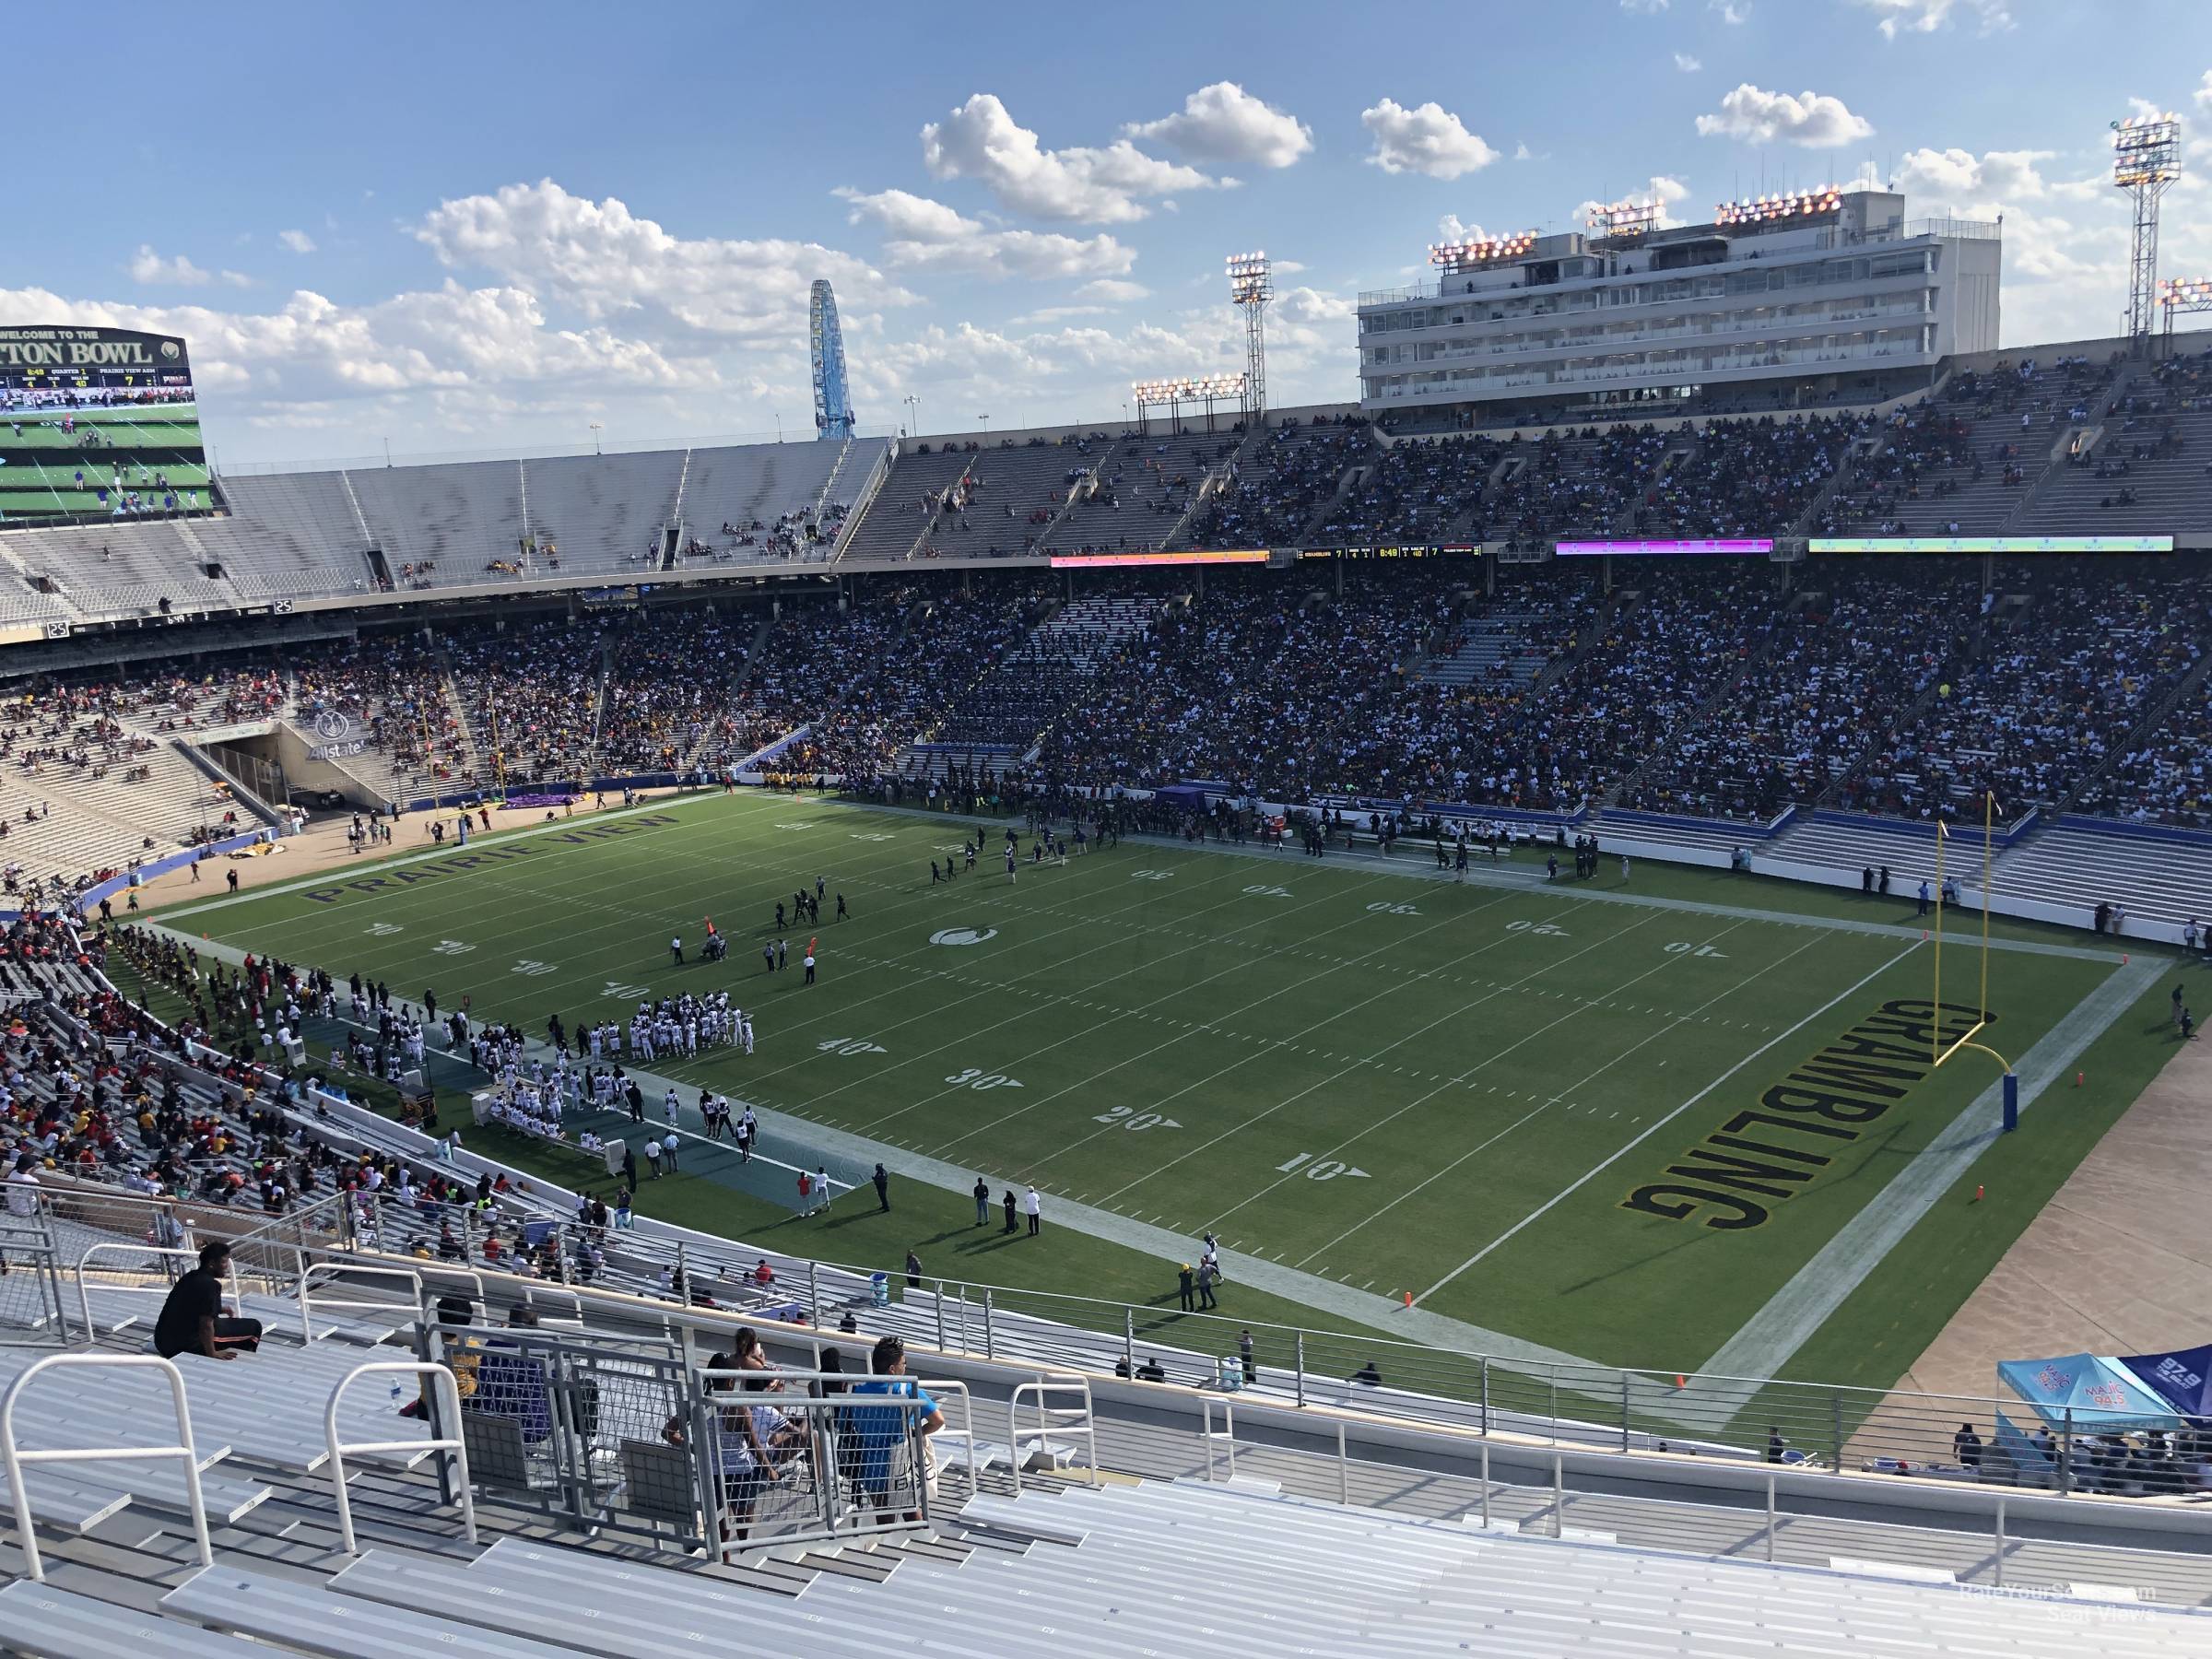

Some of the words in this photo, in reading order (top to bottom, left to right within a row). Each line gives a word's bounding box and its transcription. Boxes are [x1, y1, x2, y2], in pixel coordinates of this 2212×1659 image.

[0, 331, 56, 339] WELCOME
[58, 331, 74, 339] TO
[76, 331, 99, 339] THE
[67, 342, 153, 365] BOWL
[125, 376, 133, 386] 7
[1336, 550, 1342, 559] 7
[1380, 548, 1398, 558] 6:49
[1431, 547, 1438, 556] 7
[276, 600, 292, 612] 25
[51, 624, 66, 636] 25
[309, 741, 363, 760] Allstate
[301, 842, 548, 904] PRAIRIE
[540, 813, 681, 845] VIEW
[817, 1038, 875, 1056] 40
[945, 1068, 1006, 1090] 30
[1091, 1106, 1164, 1131] 20
[1618, 999, 1998, 1230] GRAMBLING
[1275, 1153, 1347, 1181] 10
[2159, 1357, 2203, 1387] 97.9
[2094, 1395, 2124, 1405] 94.5
